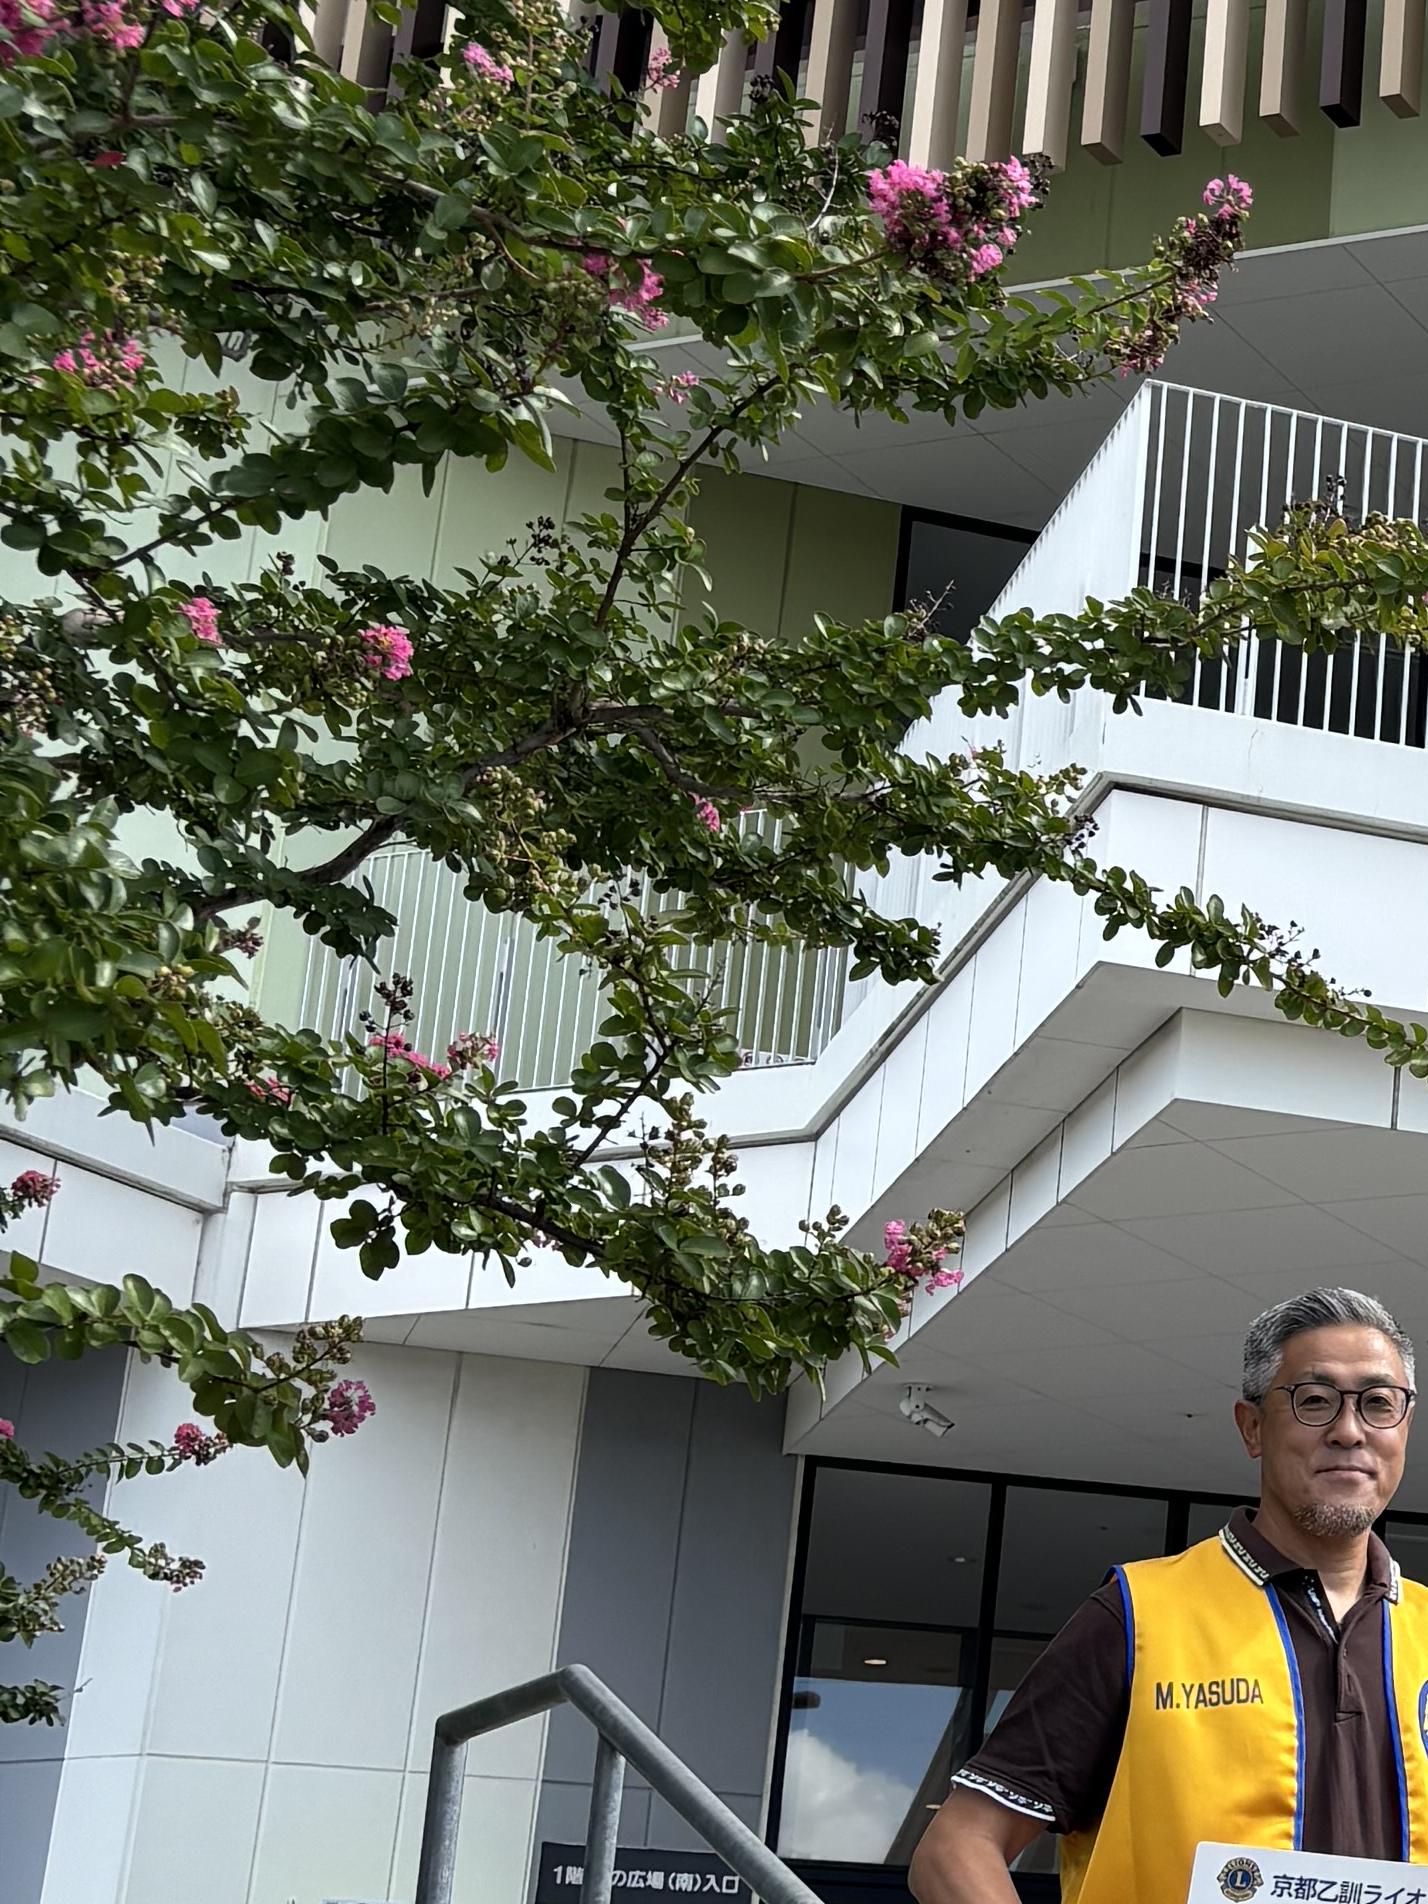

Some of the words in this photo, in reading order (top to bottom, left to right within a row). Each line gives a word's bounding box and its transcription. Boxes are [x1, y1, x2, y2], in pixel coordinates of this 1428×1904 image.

[1155, 1678, 1264, 1710] M.YASUDA
[553, 1864, 739, 1894] 1階の広場(南)入口
